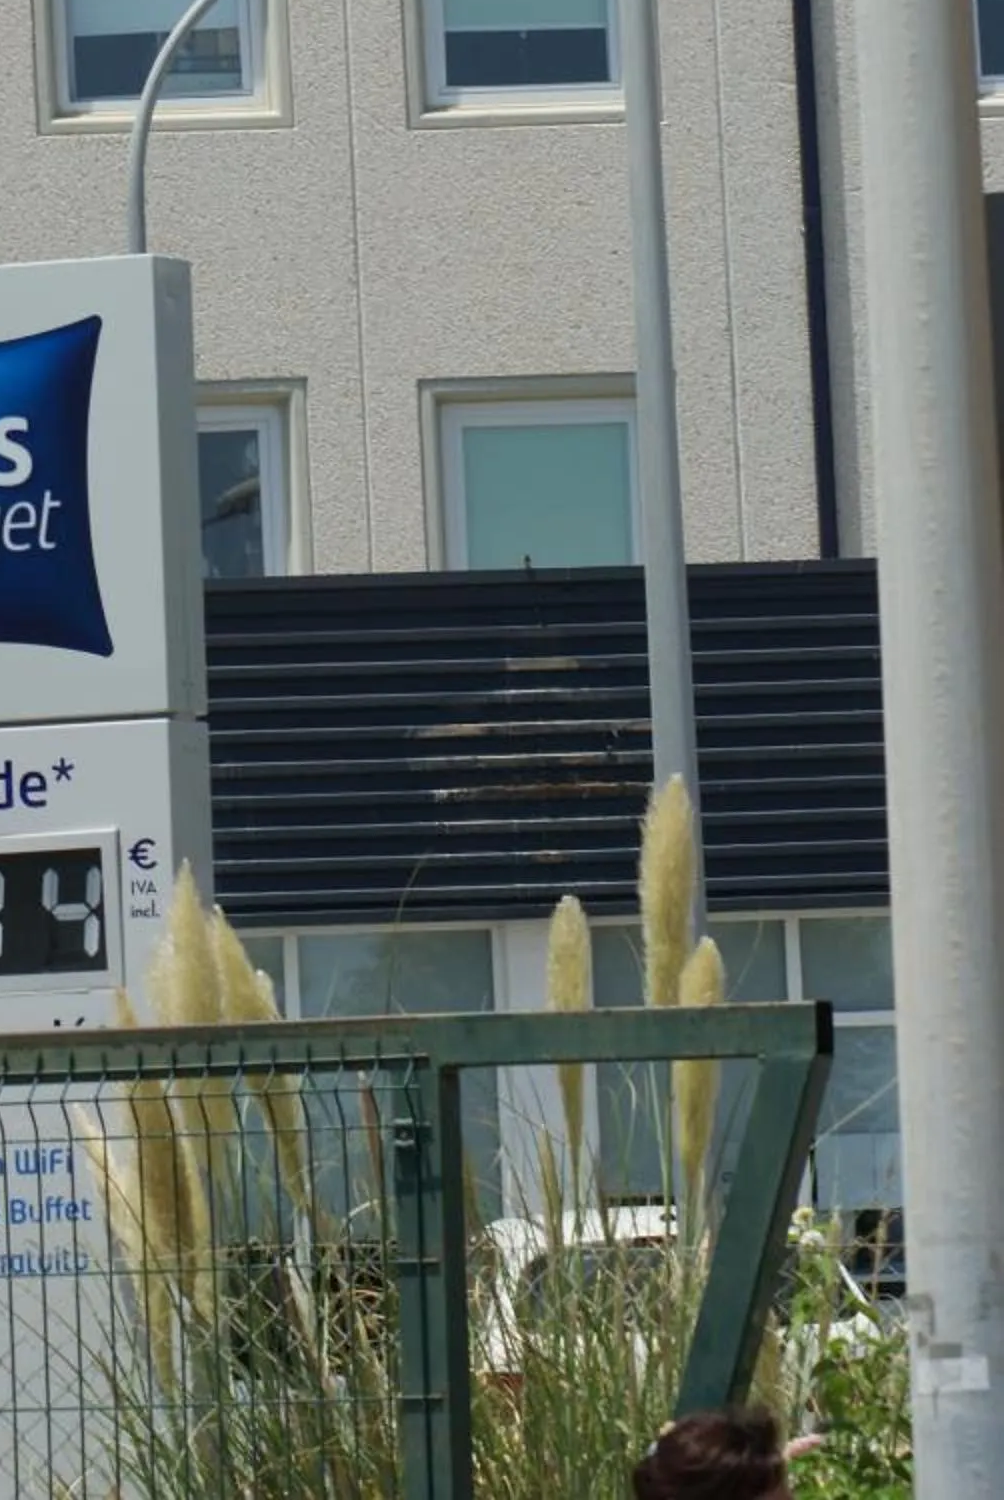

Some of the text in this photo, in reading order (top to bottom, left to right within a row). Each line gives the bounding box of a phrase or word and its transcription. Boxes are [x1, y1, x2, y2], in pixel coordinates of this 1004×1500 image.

[127, 837, 158, 870] €
[131, 879, 157, 896] IVA
[14, 1147, 74, 1175] WiFi
[9, 1195, 94, 1224] Buffet
